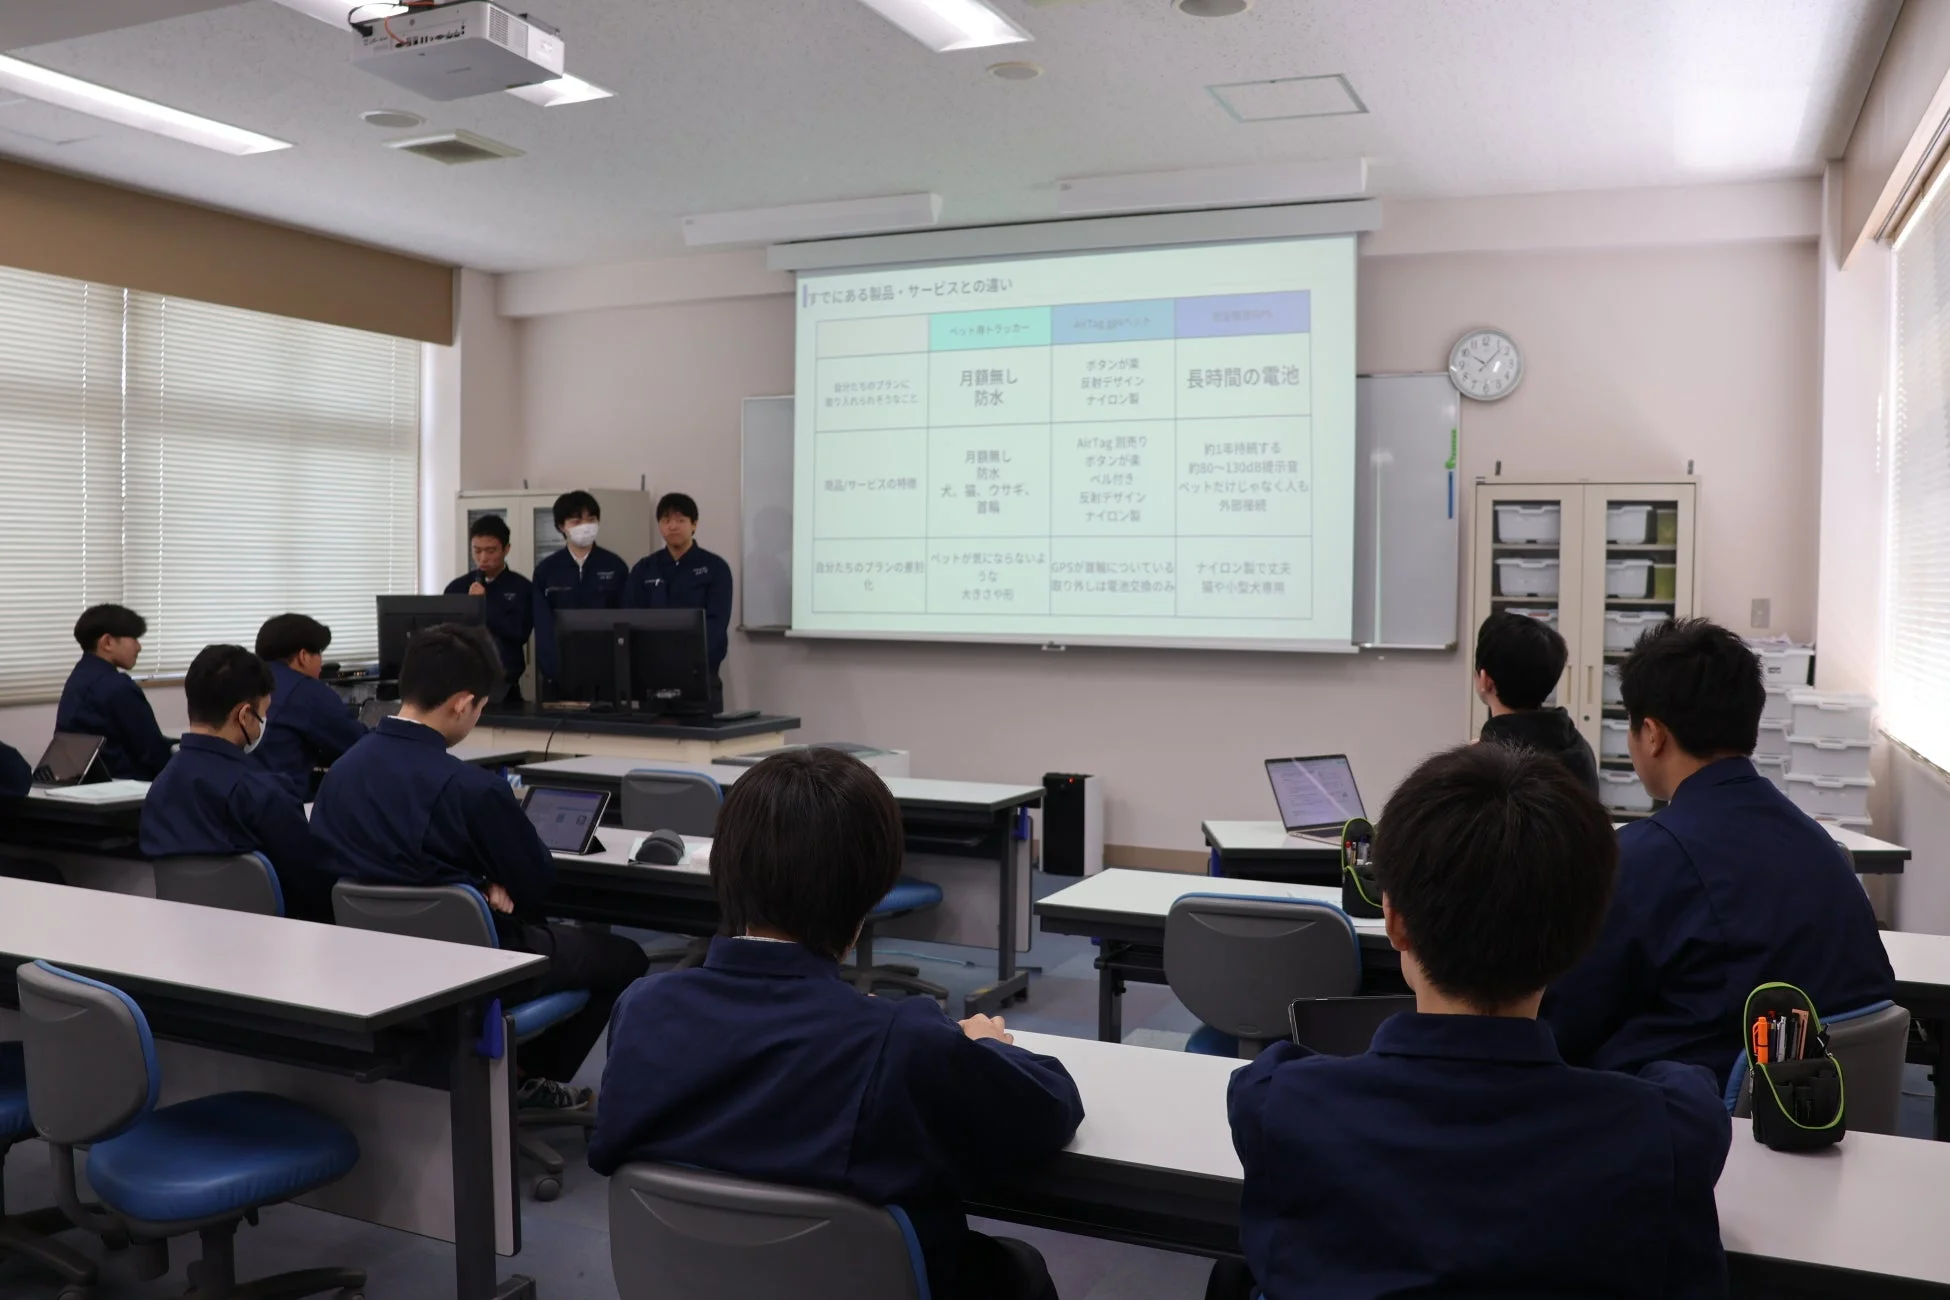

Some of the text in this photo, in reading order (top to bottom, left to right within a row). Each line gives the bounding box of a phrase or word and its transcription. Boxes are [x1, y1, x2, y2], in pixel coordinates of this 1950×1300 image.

[808, 278, 1012, 307] すでにある製品・サービスとの違い
[959, 367, 1018, 387] 月額無し
[1081, 374, 1144, 389] 反射デザイン
[1186, 364, 1300, 390] 長時間の電池
[974, 388, 1004, 407] 防水
[1085, 392, 1140, 406] ナイロン製
[1077, 436, 1112, 452] AirTag
[1204, 441, 1281, 456] 約1年持続する
[964, 449, 1012, 464] 月額無し
[976, 466, 1000, 481] 防水
[1178, 480, 1309, 494] ペットだけじゃなく人も
[1079, 491, 1146, 505] 反射デザイン
[1085, 509, 1140, 522] ナイロン製
[1196, 560, 1291, 575] ナイロン製で丈夫
[864, 578, 874, 591] 化
